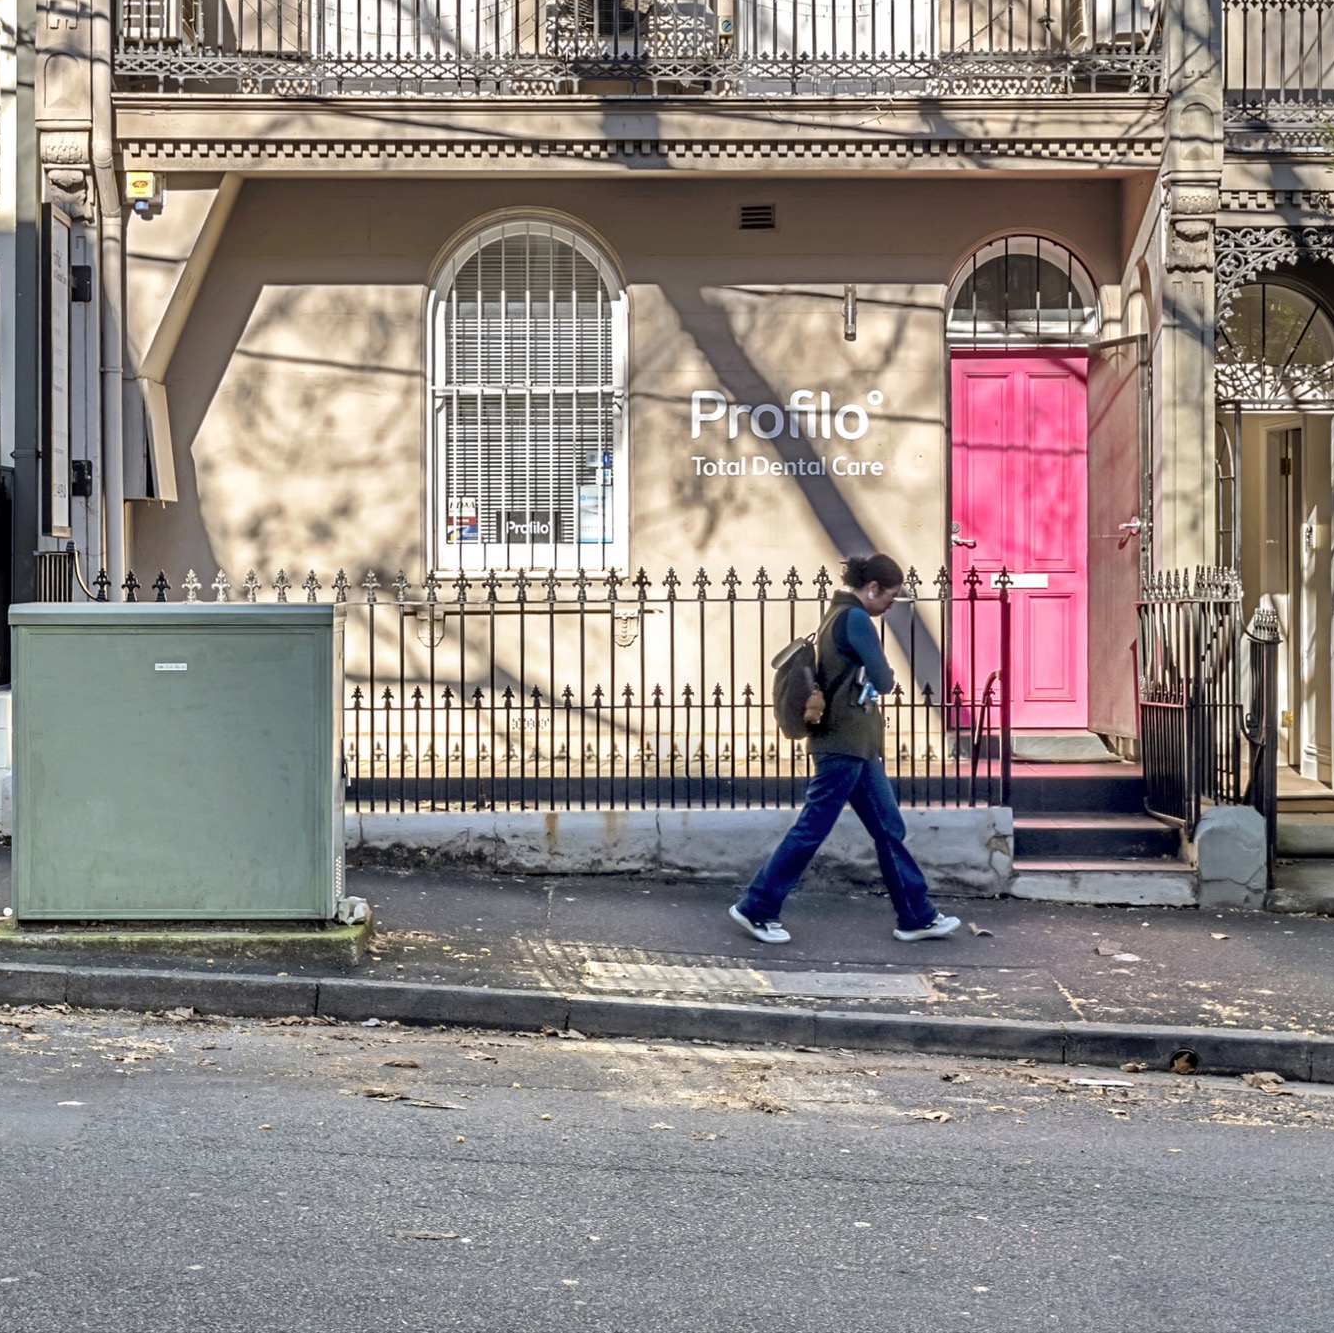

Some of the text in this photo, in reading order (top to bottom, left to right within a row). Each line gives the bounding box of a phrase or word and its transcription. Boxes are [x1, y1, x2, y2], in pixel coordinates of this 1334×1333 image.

[691, 456, 884, 476] Total Dental Care
